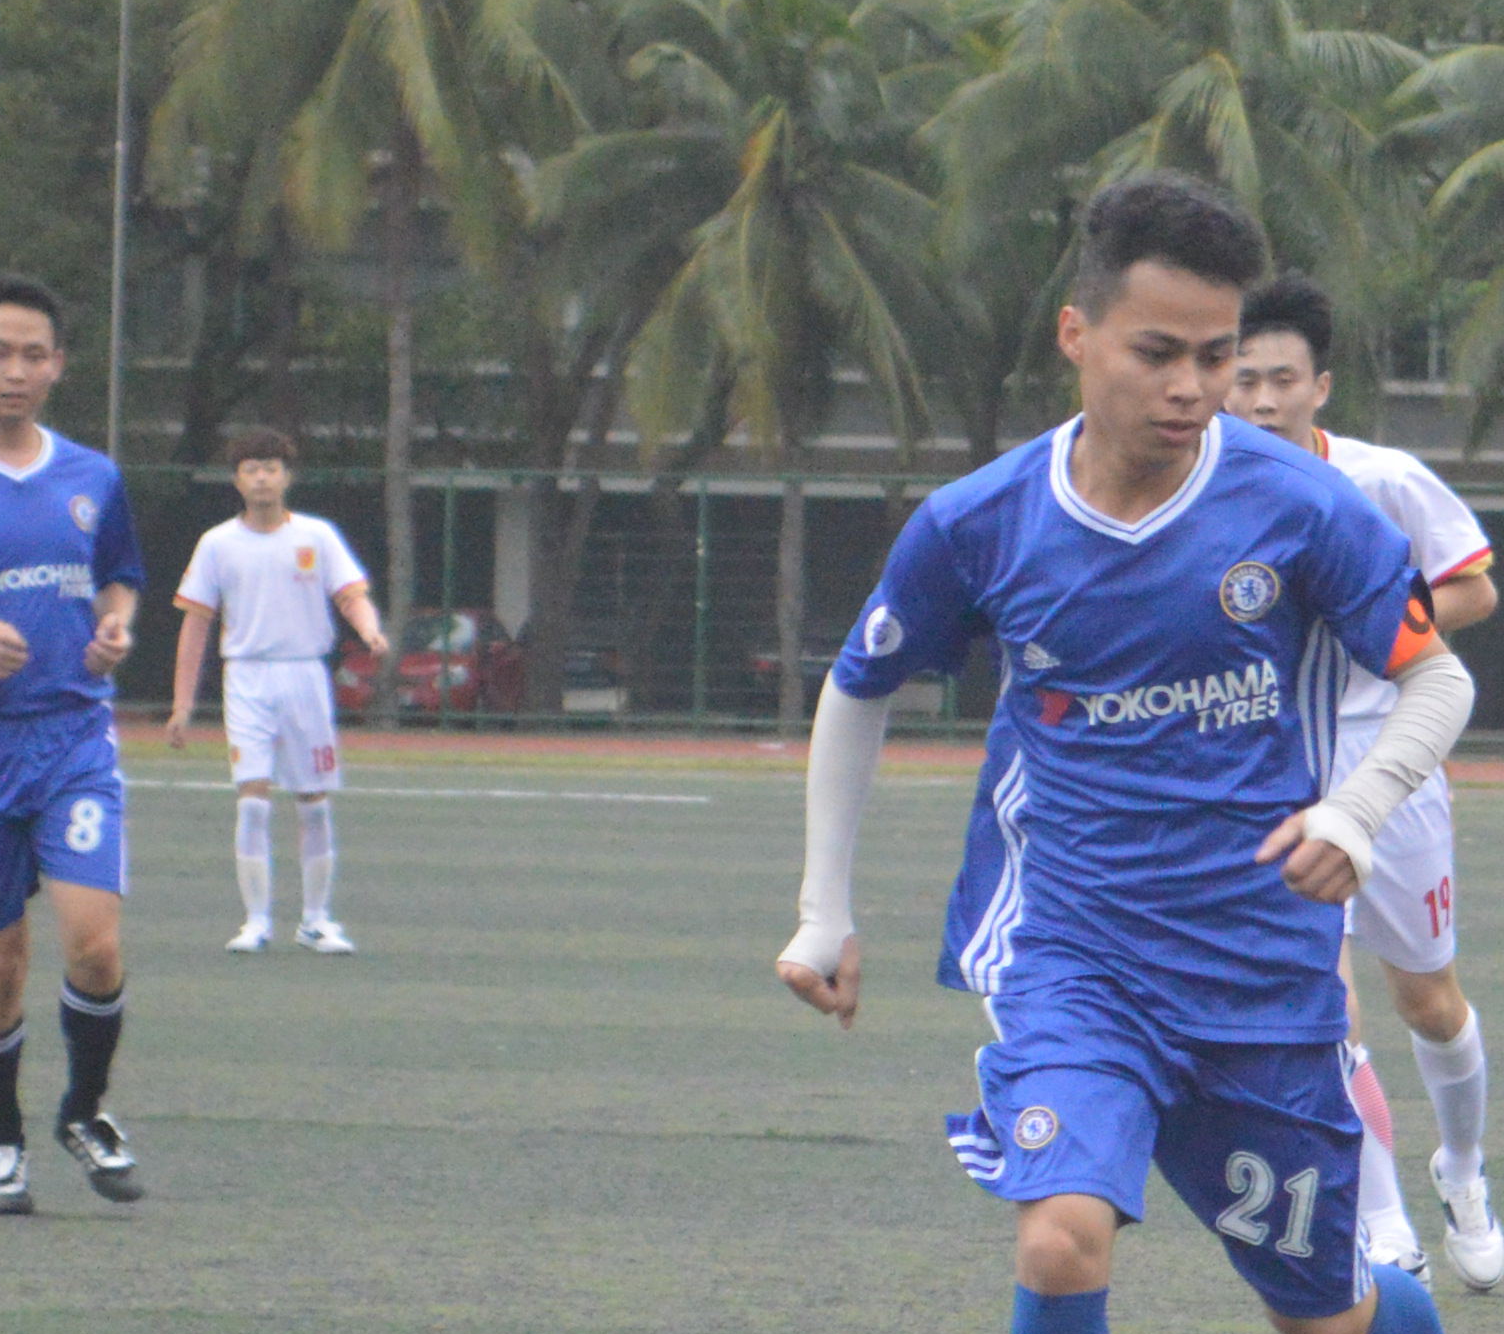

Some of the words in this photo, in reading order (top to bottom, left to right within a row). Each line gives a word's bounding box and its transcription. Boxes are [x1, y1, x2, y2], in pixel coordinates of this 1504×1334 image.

[1075, 658, 1278, 726] YOKOHAMA
[1196, 690, 1280, 734] TYRES
[64, 798, 104, 854] 8
[1215, 1150, 1320, 1259] 21
